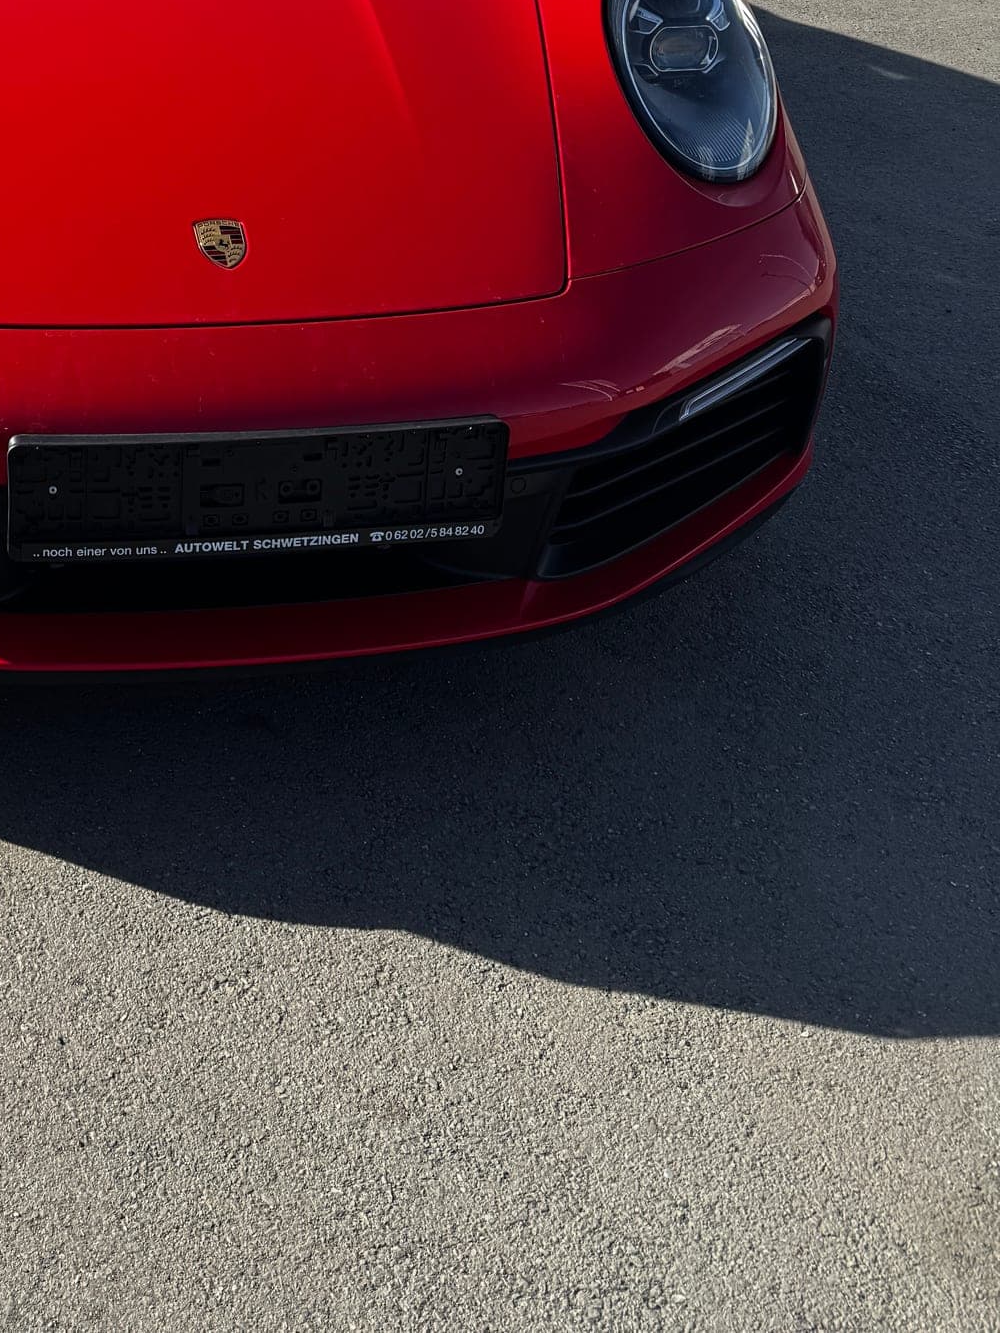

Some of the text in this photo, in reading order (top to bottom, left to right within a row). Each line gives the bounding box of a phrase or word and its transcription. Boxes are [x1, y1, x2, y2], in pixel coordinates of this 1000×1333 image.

[76, 546, 107, 557] einer
[110, 547, 132, 556] von
[174, 540, 248, 554] AUTOWELT
[253, 533, 359, 550] SCHWETZINGEN
